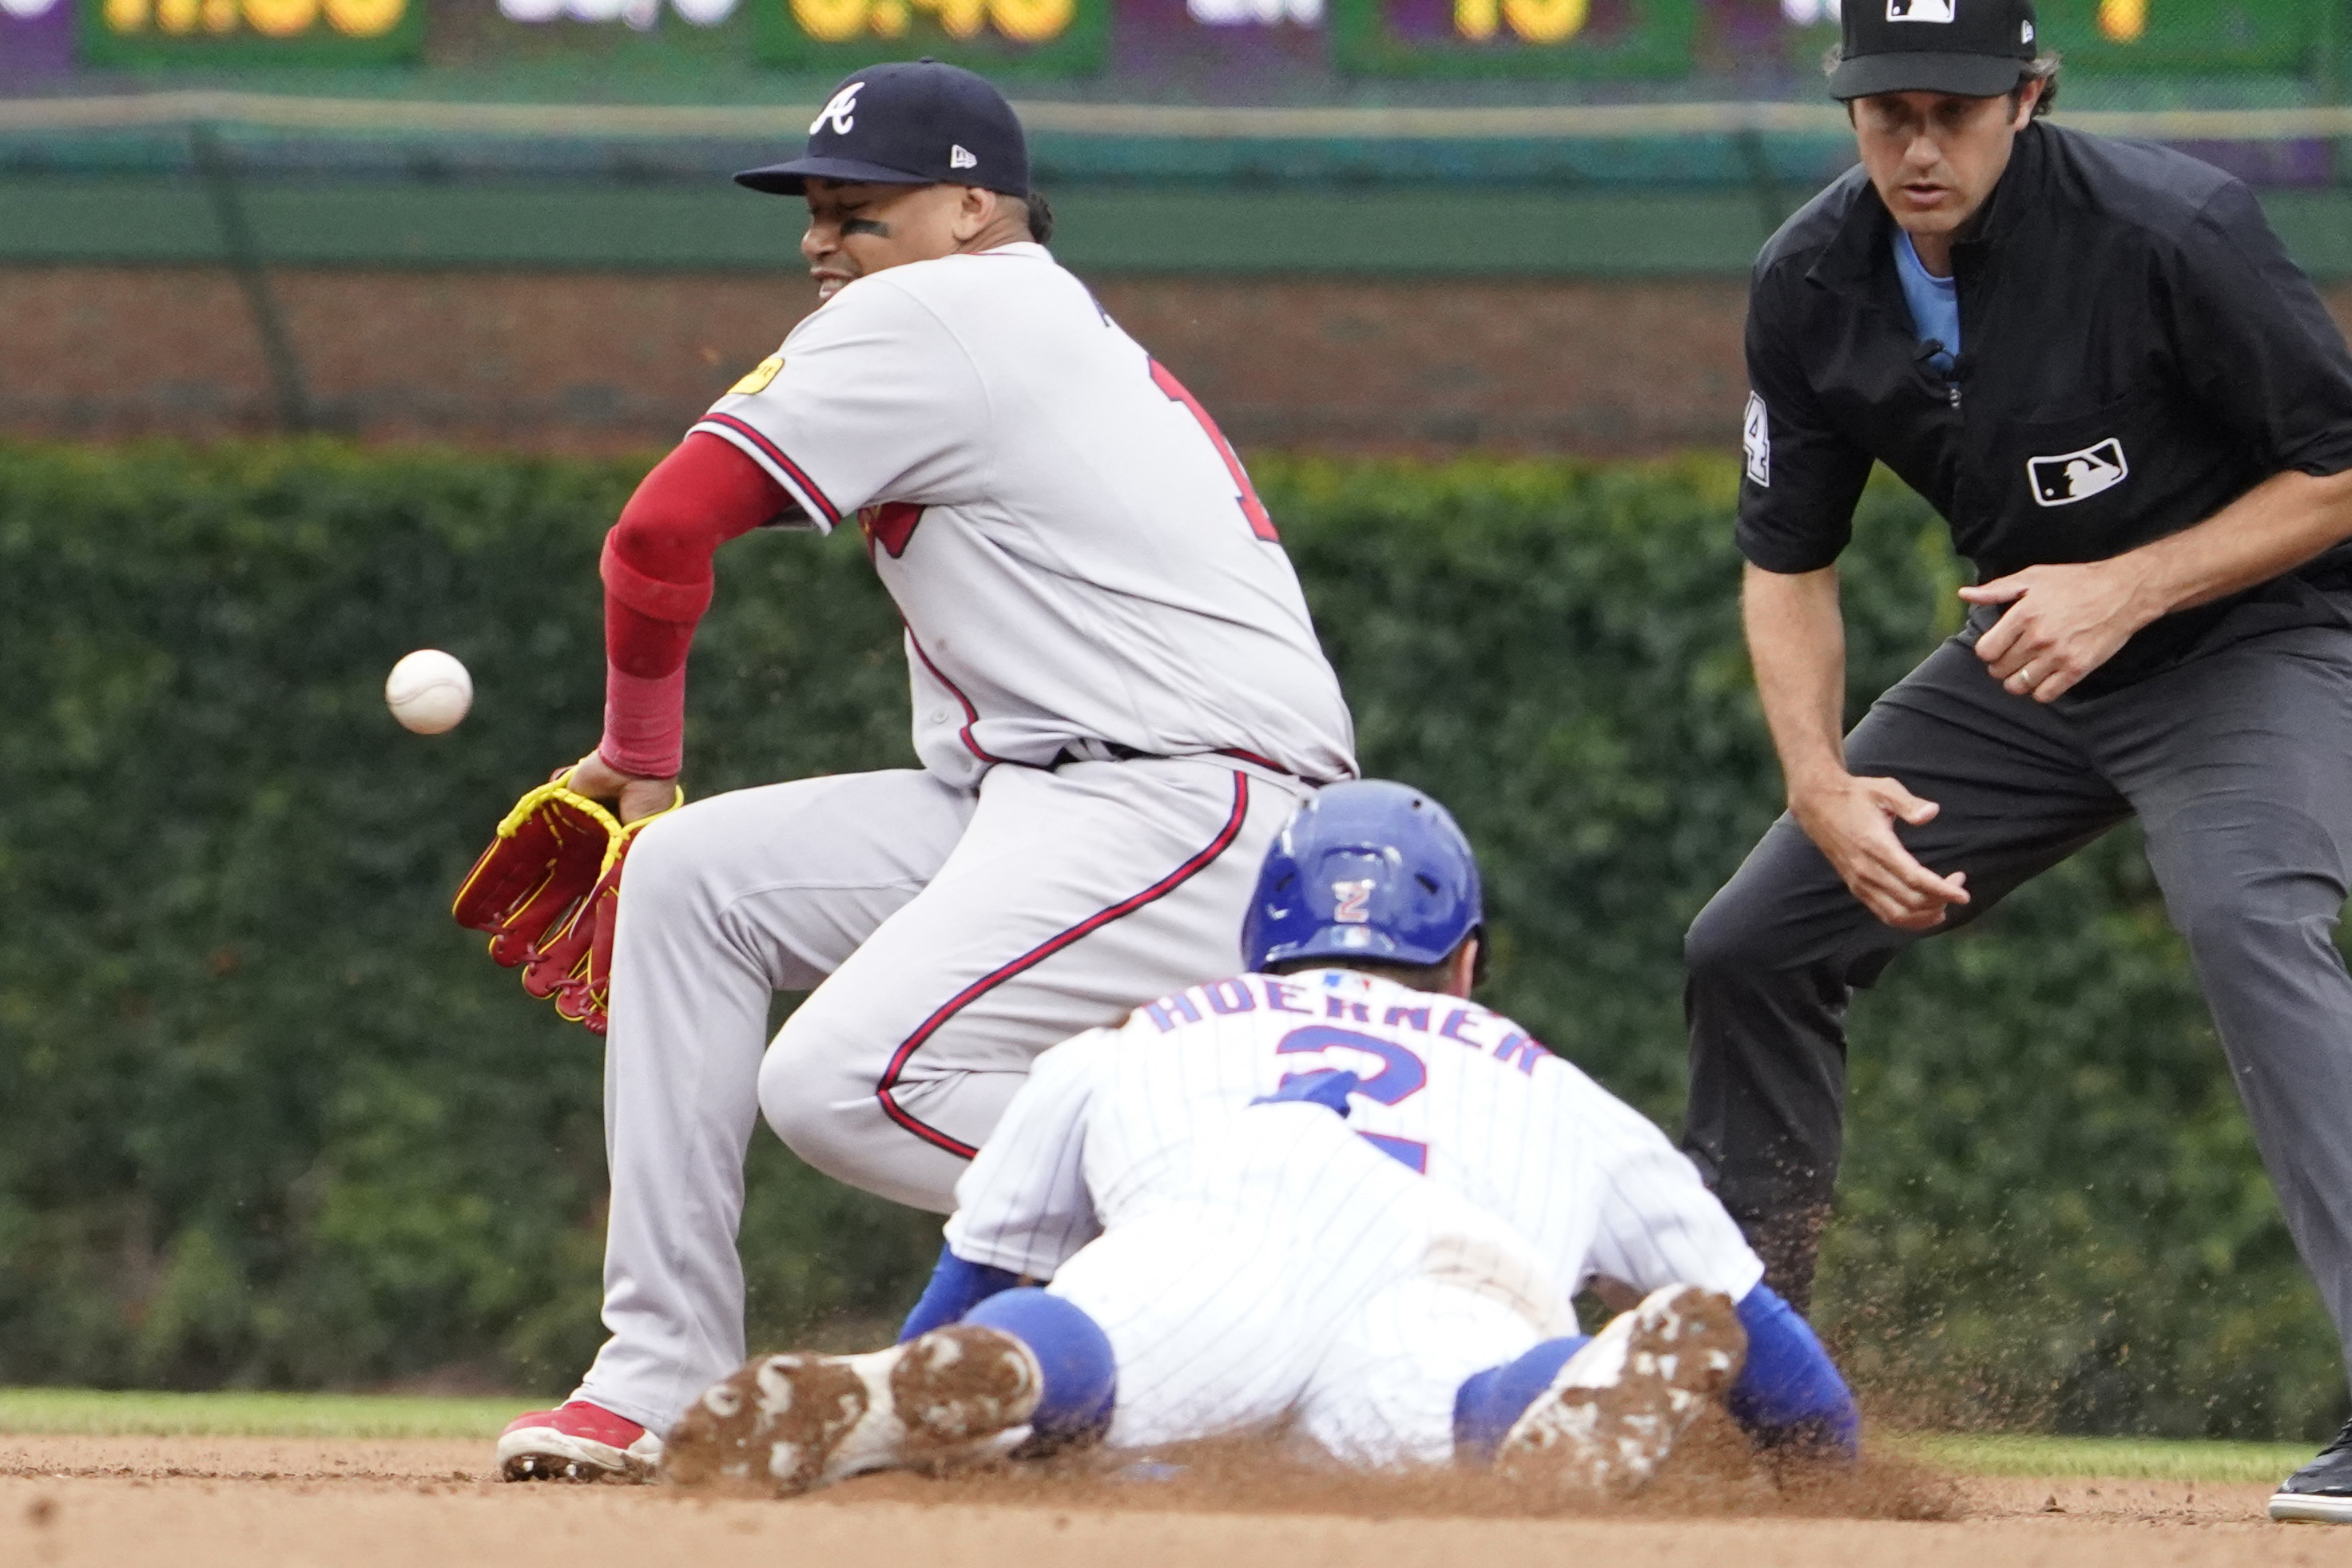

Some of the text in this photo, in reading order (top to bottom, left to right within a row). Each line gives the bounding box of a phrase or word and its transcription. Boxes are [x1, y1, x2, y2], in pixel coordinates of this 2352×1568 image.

[809, 81, 865, 135] A
[1743, 390, 1770, 487] 4
[1143, 978, 1553, 1076] HOERNER
